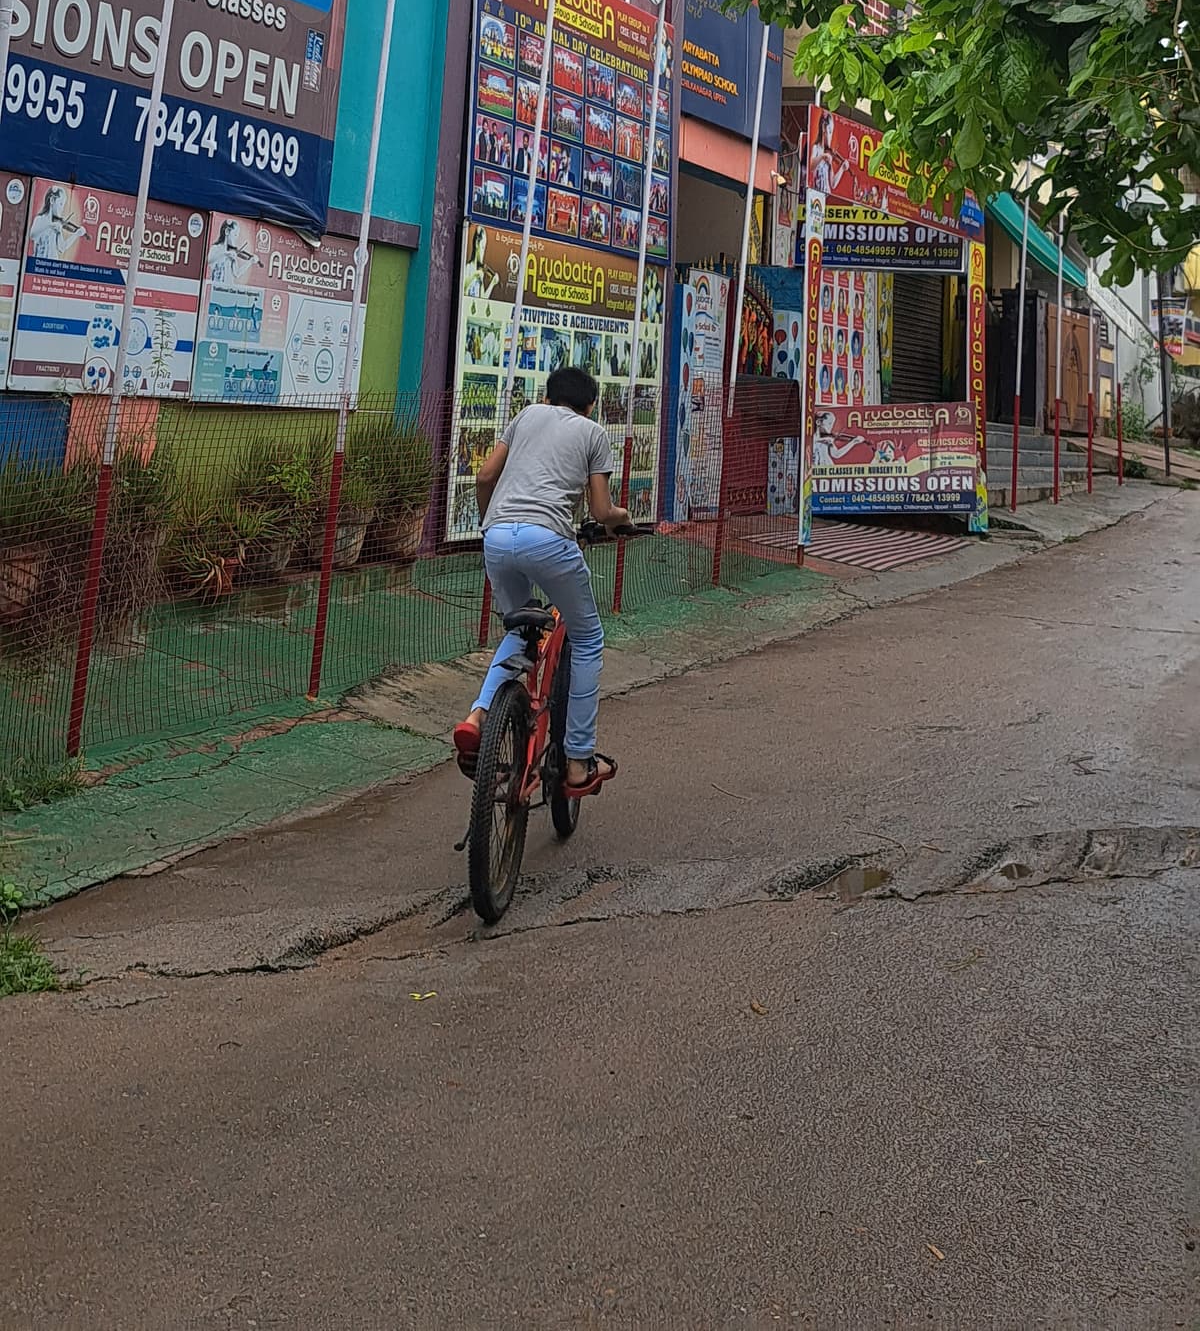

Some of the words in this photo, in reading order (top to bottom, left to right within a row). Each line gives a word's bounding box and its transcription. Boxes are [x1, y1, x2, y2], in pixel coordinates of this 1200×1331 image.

[579, 14, 601, 35] Schools
[534, 20, 570, 48] ANUAL
[572, 38, 588, 56] DAY
[590, 46, 649, 82] CELEBRATIONS
[683, 39, 720, 68] ARYABATTA
[180, 30, 301, 117] OPEN
[681, 60, 713, 85] OLYMPIAD
[714, 75, 739, 97] SCHOOL
[135, 95, 219, 158] 78424
[228, 121, 299, 177] 13999
[878, 164, 900, 183] Group
[802, 208, 859, 220] NSERY
[863, 209, 878, 220] TO
[800, 223, 909, 243] MISSIONS
[115, 244, 131, 256] Grou
[146, 249, 171, 262] Schools
[836, 244, 896, 256] 040-48549955
[903, 247, 930, 257] 78424
[933, 247, 959, 258] 13999
[286, 271, 305, 283] Group
[307, 277, 314, 285] of
[315, 278, 339, 289] Schools
[541, 282, 559, 299] Group
[561, 286, 567, 296] of
[568, 286, 589, 301] Schools
[510, 306, 560, 327] TIVITIES
[562, 314, 568, 327] &
[569, 314, 630, 335] ACHIEVEMENTS
[926, 475, 974, 491] OPEN
[819, 496, 846, 504] Contact
[851, 494, 904, 503] 040-48549955
[911, 493, 935, 502] 78424
[937, 493, 960, 502] 13999
